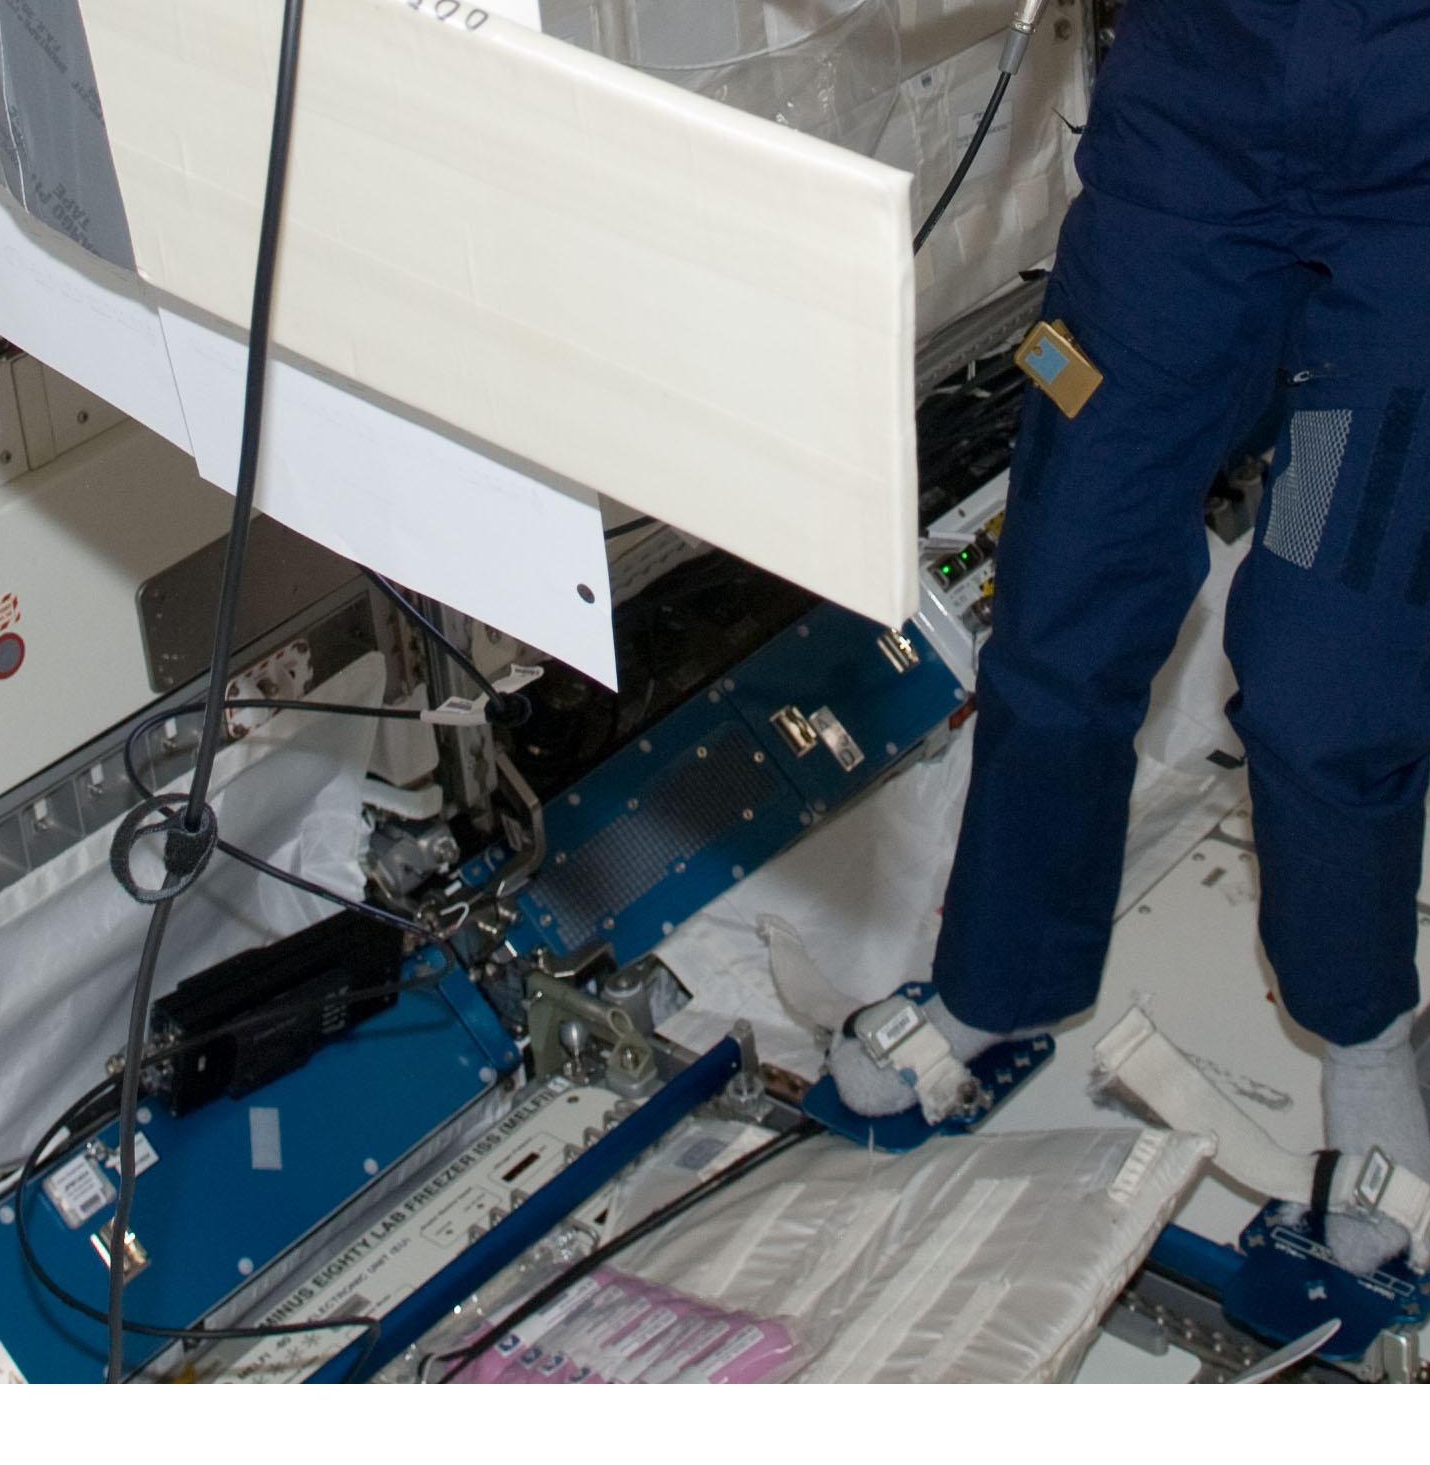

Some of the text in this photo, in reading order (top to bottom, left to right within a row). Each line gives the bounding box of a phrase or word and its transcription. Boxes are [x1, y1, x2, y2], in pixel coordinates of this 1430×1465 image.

[258, 1285, 315, 1331] MINUS
[312, 1240, 374, 1289] EIGHTY
[372, 1211, 407, 1241] LAB
[405, 1156, 475, 1213] FREEZER
[472, 1131, 503, 1158] ISS
